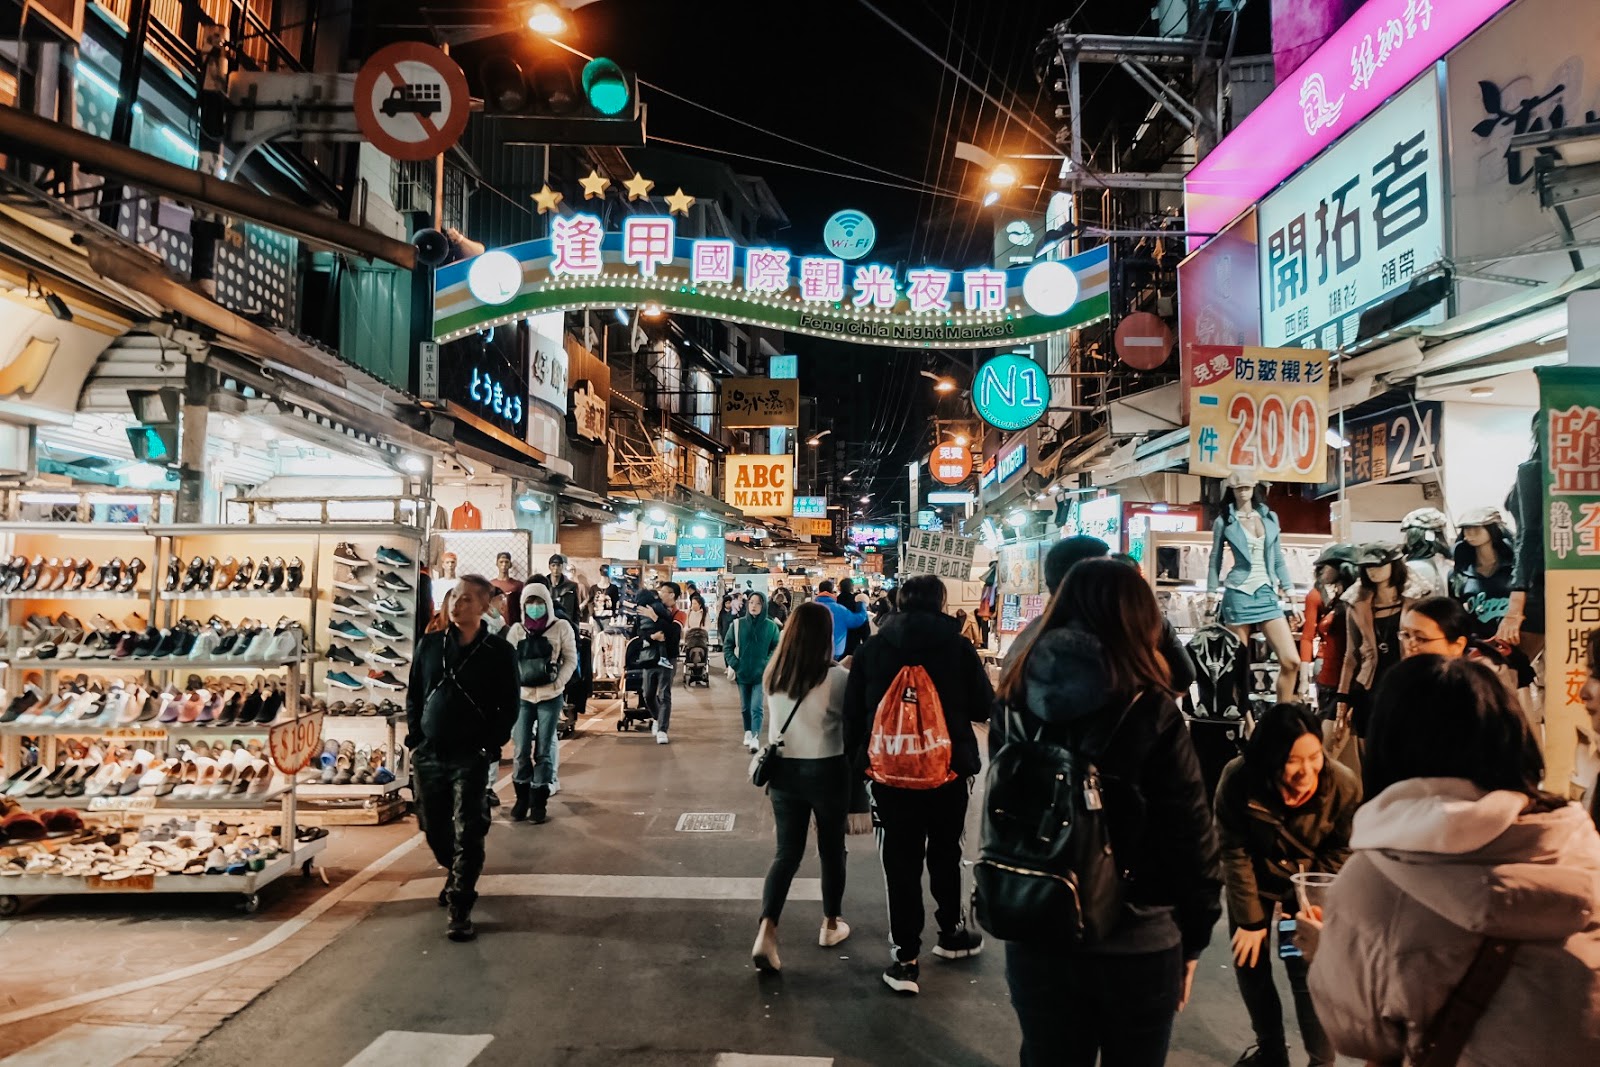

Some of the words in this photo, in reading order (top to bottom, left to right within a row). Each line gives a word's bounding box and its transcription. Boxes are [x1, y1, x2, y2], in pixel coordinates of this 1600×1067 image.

[1268, 130, 1428, 312] 開拓者
[551, 212, 1008, 314] 逢甲國際觀光夜市
[1285, 306, 1309, 338] 西服
[1381, 248, 1415, 290] 領帶
[801, 315, 844, 333] Feng
[847, 321, 890, 336] Chia
[893, 326, 943, 340] Night
[945, 321, 1014, 340] Market
[470, 367, 522, 424] とうきょう
[981, 365, 1043, 407] N1
[1235, 358, 1323, 383] 防皺襯衫
[1198, 396, 1218, 462] 一件
[1227, 392, 1319, 474] 200
[733, 491, 785, 506] MART
[735, 464, 785, 488] ABC
[1551, 502, 1572, 558] 逢甲
[280, 719, 315, 762] $190
